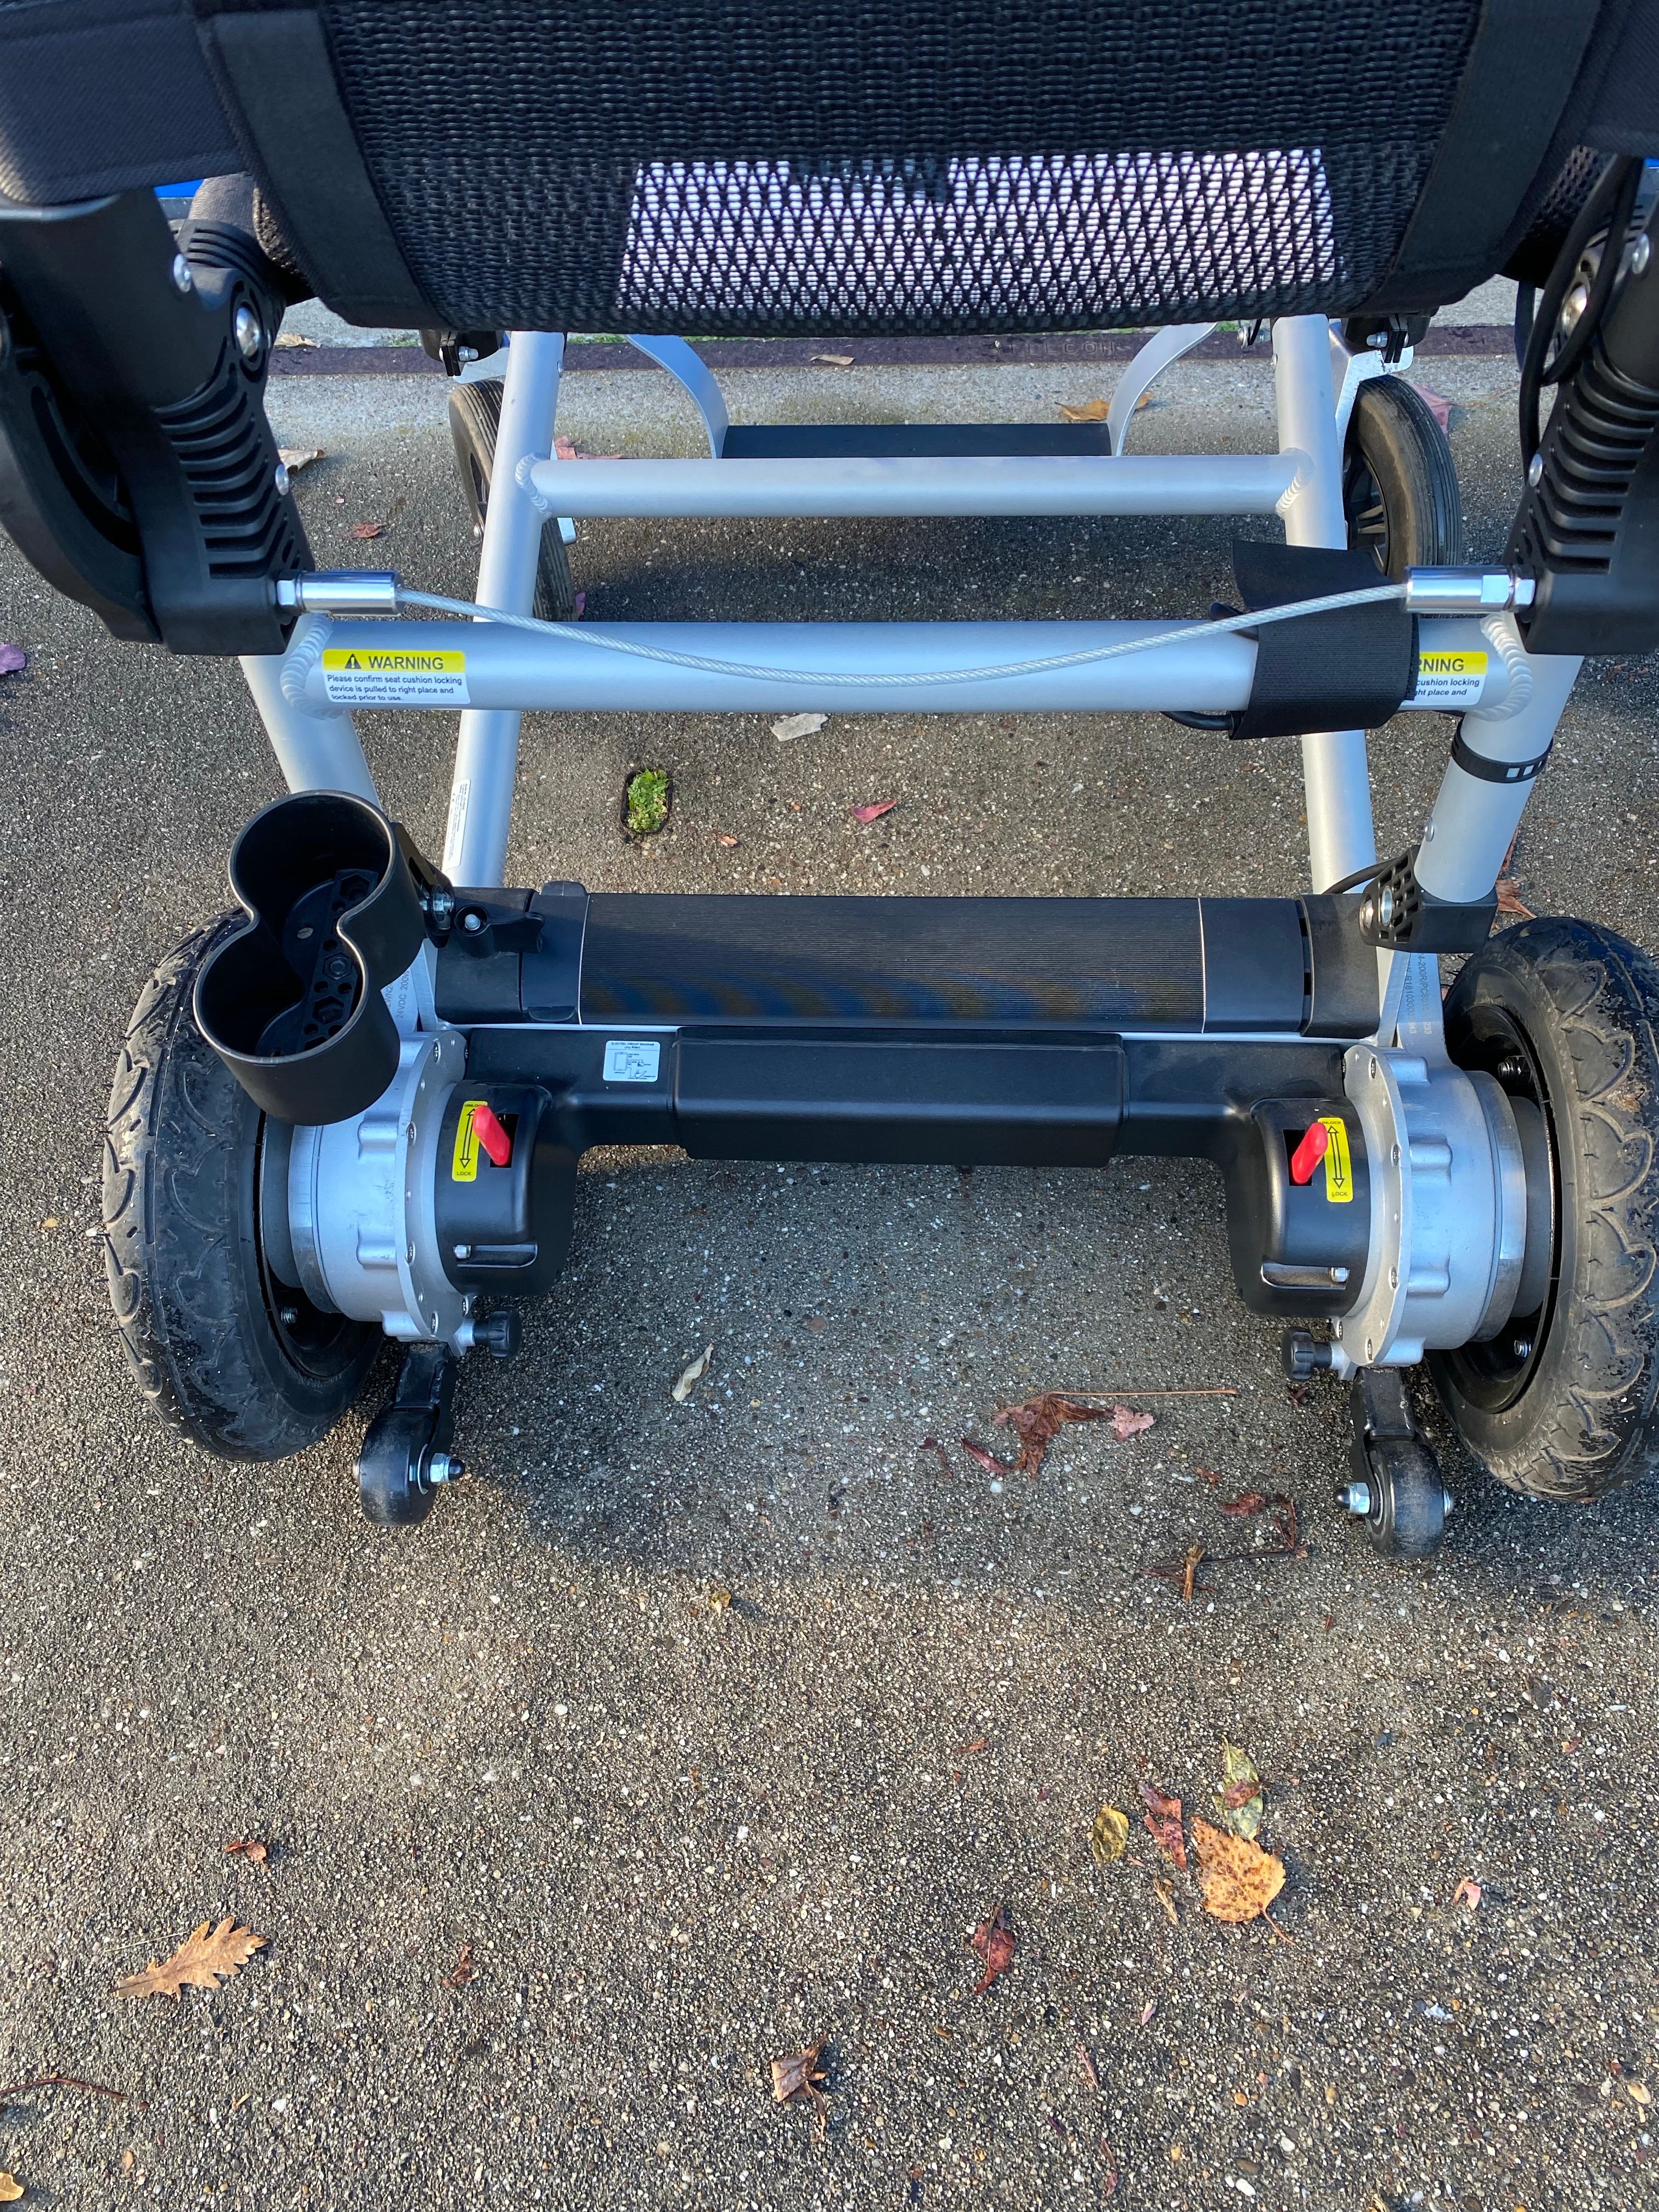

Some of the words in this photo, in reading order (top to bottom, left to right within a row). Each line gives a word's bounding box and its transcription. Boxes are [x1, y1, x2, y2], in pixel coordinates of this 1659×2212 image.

[368, 656, 444, 670] WARNING
[1419, 658, 1464, 672] NING
[435, 676, 462, 685] locking
[1451, 678, 1480, 687] locking
[396, 994, 407, 1019] 24VDC
